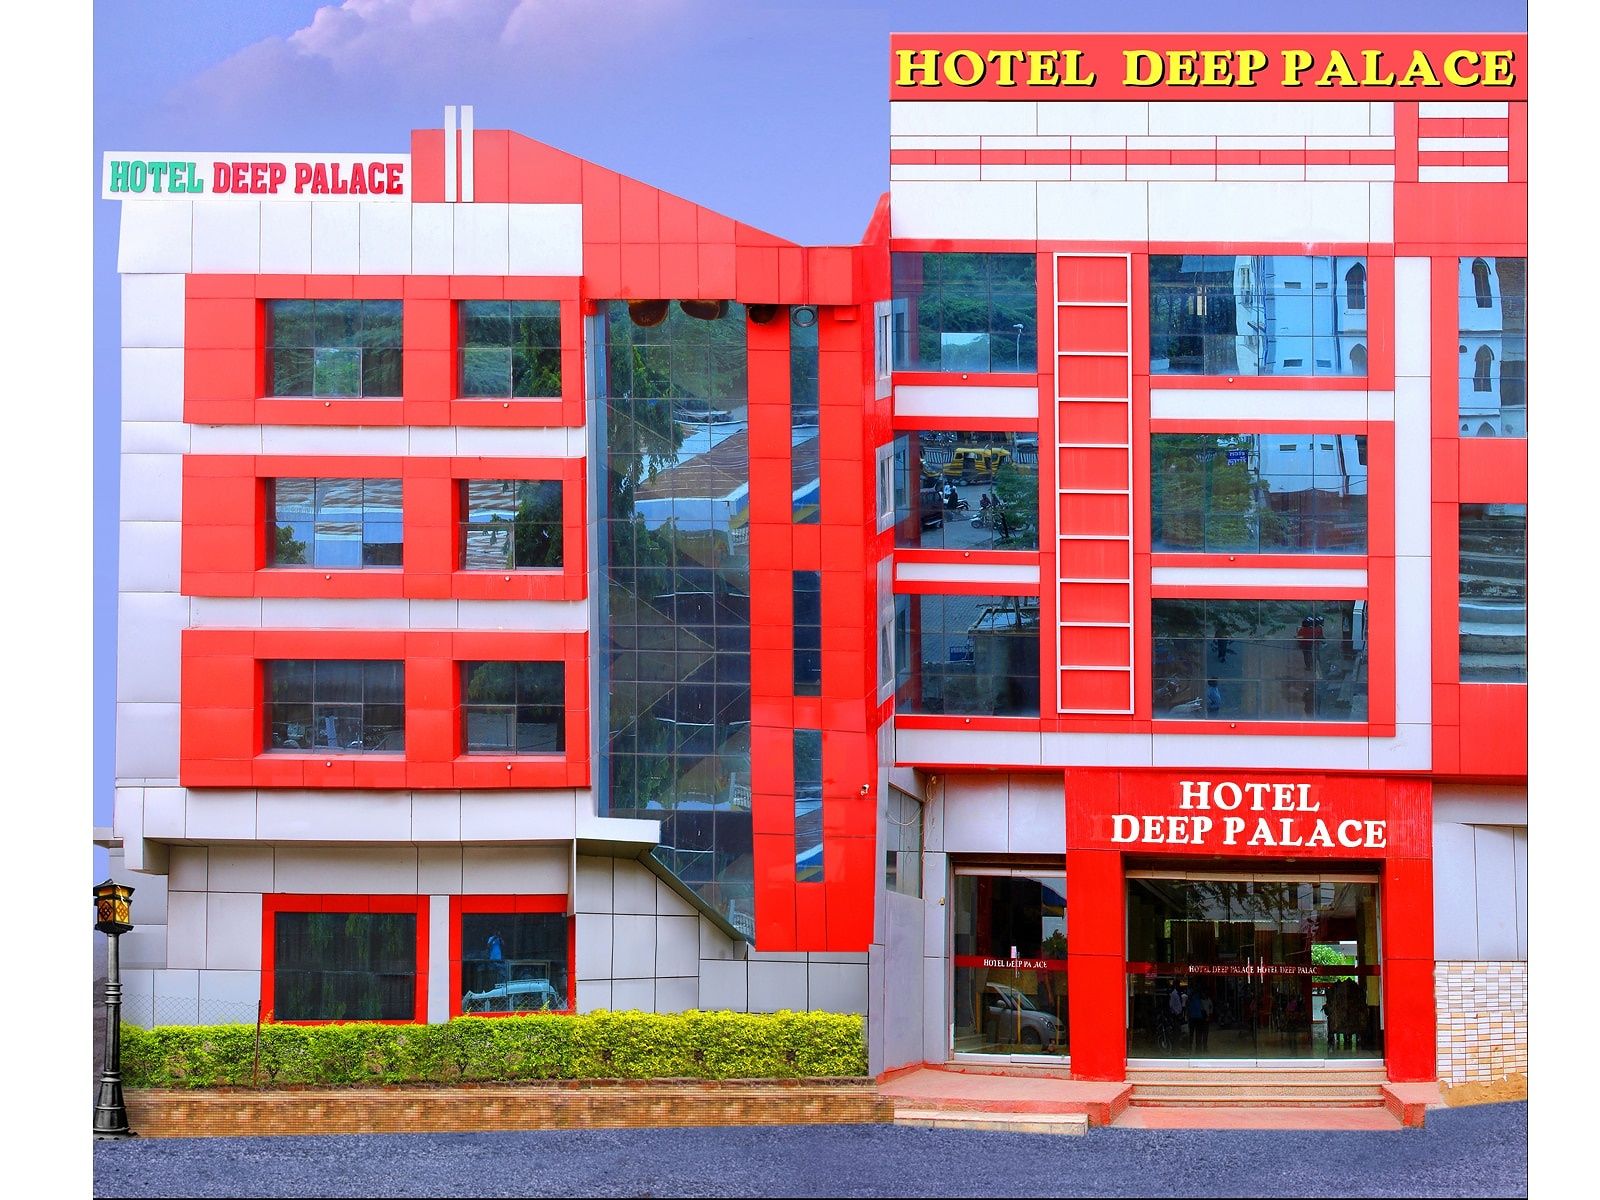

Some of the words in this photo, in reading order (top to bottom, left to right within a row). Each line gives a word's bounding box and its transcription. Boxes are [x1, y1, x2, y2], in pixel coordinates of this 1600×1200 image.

[895, 49, 1097, 87] HOTEL
[1122, 49, 1268, 87] DEEP
[1281, 49, 1516, 87] PALACE
[110, 160, 204, 193] HOTEL
[212, 162, 287, 194] DEEP
[294, 162, 404, 195] PALACE
[1179, 780, 1321, 812] HOTEL
[1110, 814, 1213, 845] DEEP
[1223, 815, 1387, 848] PALACE
[983, 959, 1005, 968] HOTEL
[1189, 965, 1211, 973] HOTEL
[1212, 965, 1229, 973] DEEP
[1256, 966, 1278, 974] HOTEL
